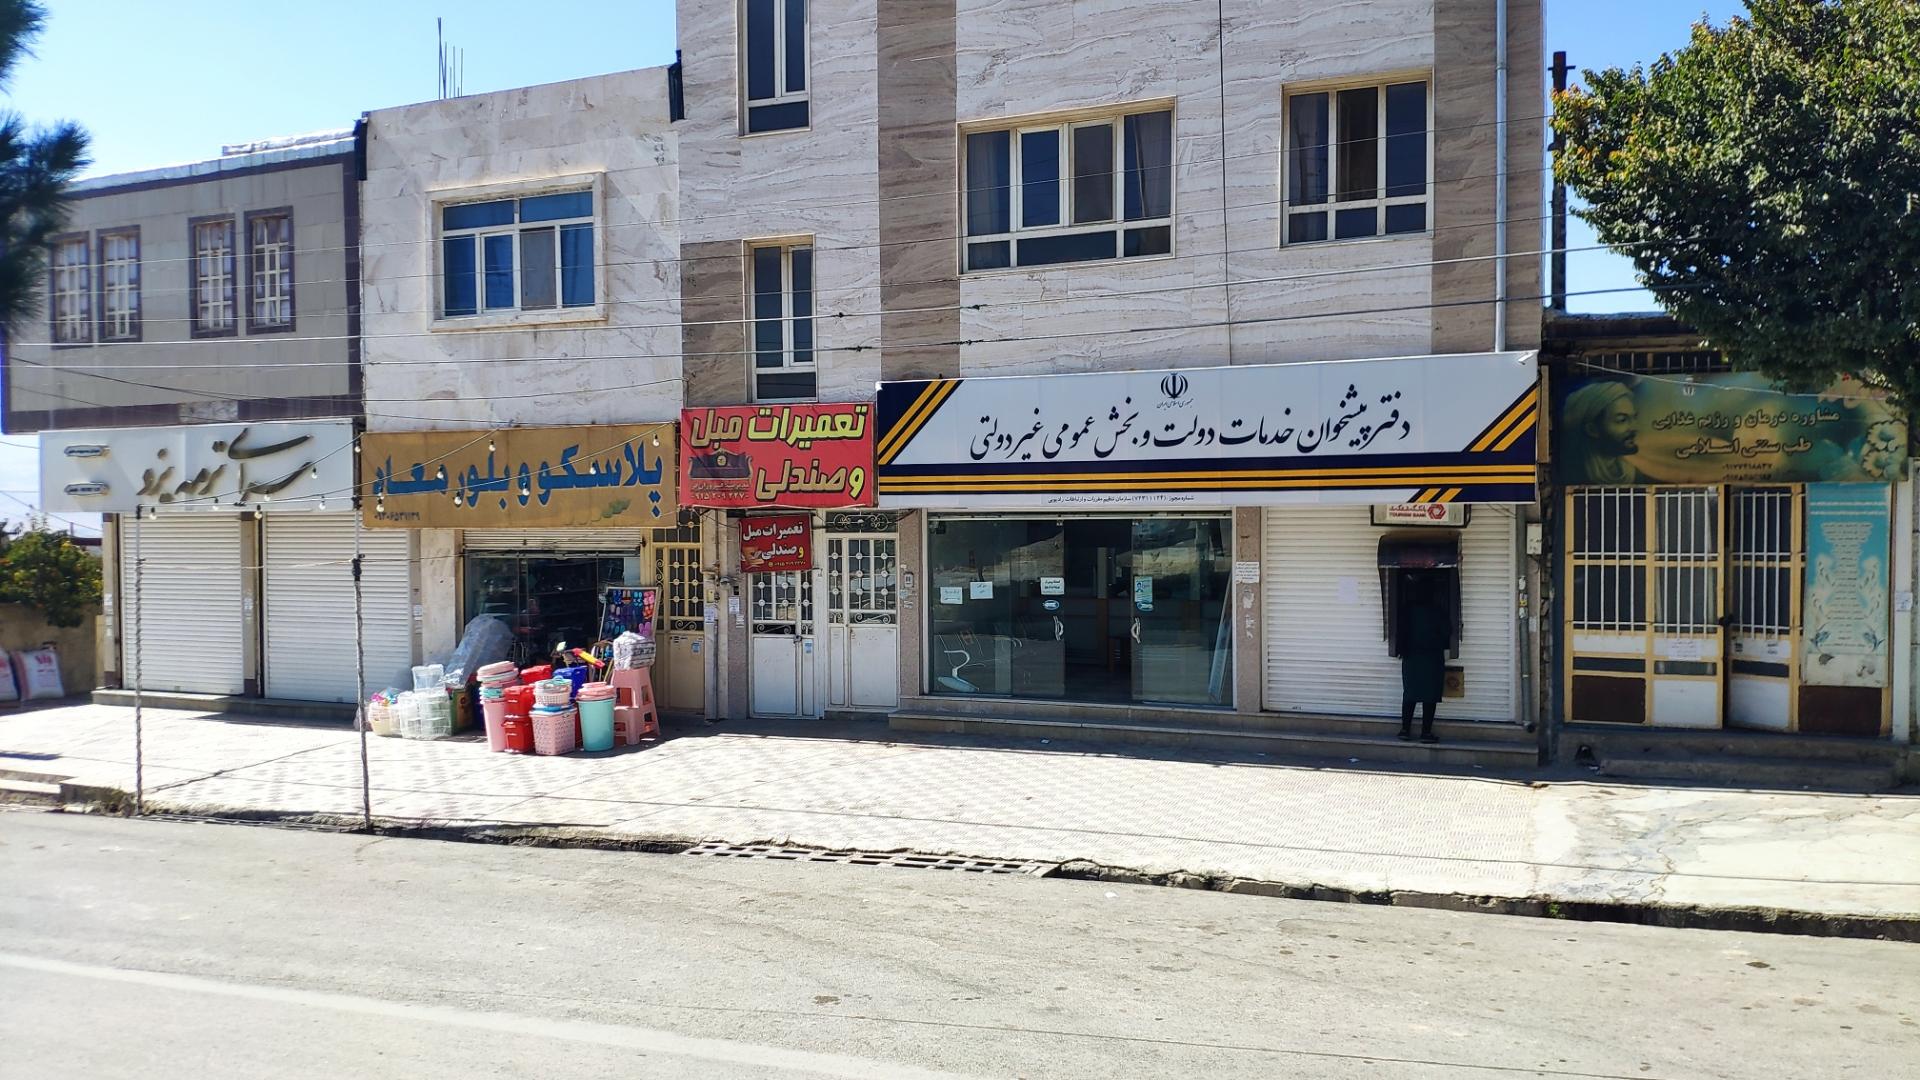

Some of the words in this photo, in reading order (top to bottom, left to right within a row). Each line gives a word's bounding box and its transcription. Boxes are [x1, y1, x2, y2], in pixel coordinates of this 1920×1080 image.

[690, 409, 743, 450] مبل
[746, 404, 869, 450] تعمیرات
[1094, 396, 1140, 458] بخش
[1152, 413, 1215, 449] دولت
[1218, 407, 1295, 445] خدمات
[1297, 383, 1370, 453] پیشخوان
[1359, 390, 1411, 450] دفتر
[1653, 411, 1695, 431] غذایی
[1733, 415, 1742, 428] و
[1745, 409, 1788, 429] درمان
[1792, 407, 1840, 428] مشاوره
[1042, 415, 1096, 459] عمومی
[1139, 429, 1151, 448] و
[1676, 438, 1740, 459] اسلامی
[1741, 439, 1781, 458] سنتی
[1782, 437, 1812, 456] طب
[454, 451, 511, 509] بلور
[517, 461, 533, 506] و
[537, 441, 663, 518] پلاسکو
[754, 459, 847, 502] صندلی
[848, 466, 866, 500] و
[743, 524, 762, 541] مبل
[763, 521, 804, 540] تعمیرات
[761, 543, 797, 560] صندلی
[797, 545, 805, 558] و
